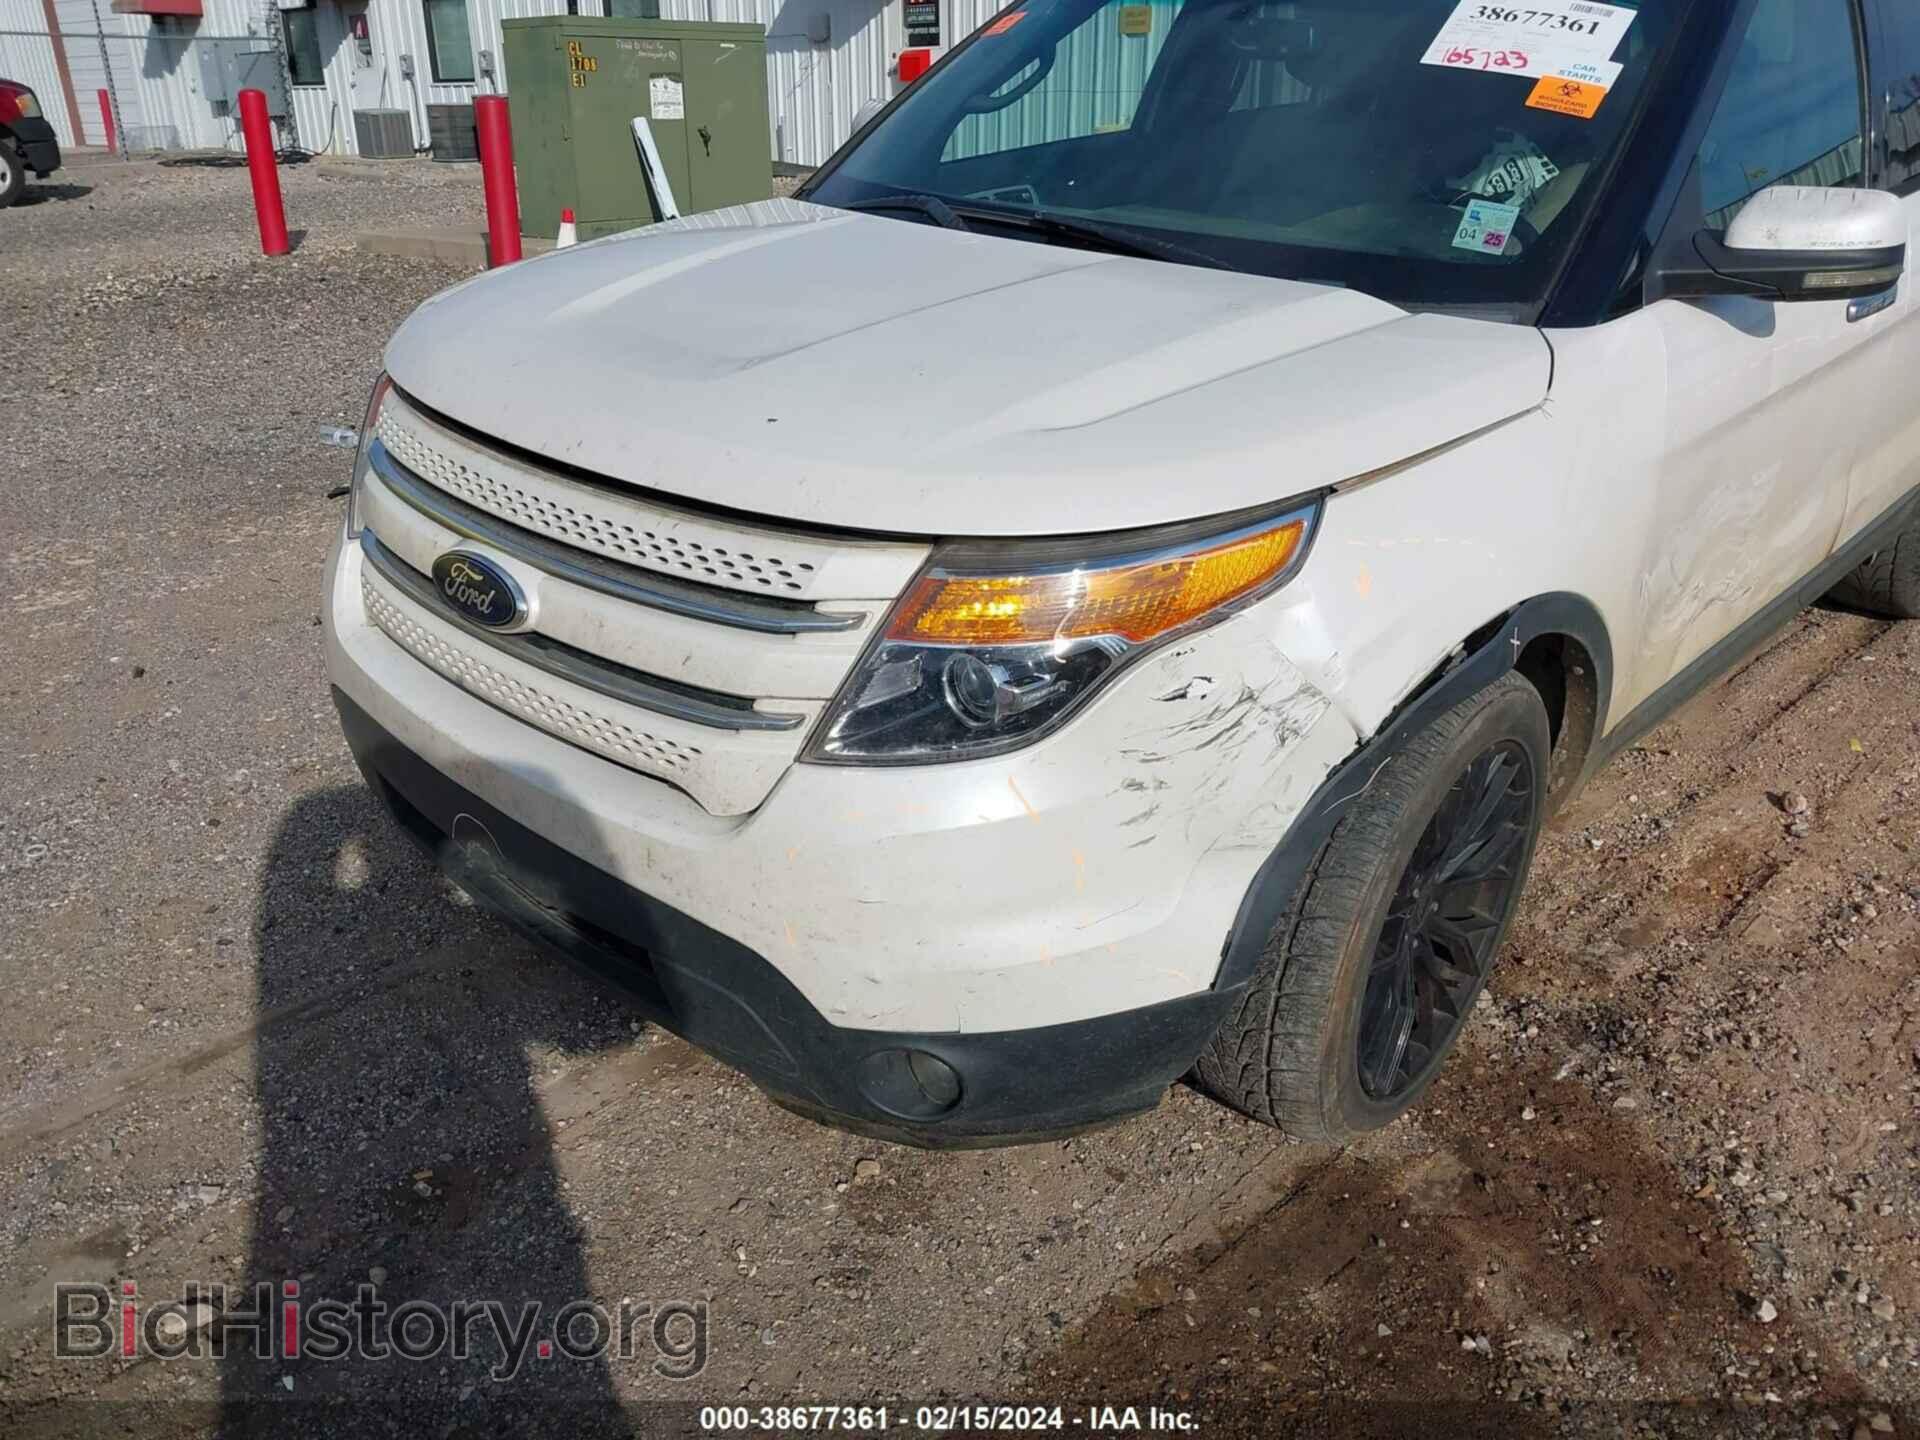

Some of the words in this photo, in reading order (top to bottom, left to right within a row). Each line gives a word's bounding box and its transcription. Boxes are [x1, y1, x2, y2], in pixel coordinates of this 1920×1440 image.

[1469, 5, 1600, 35] 38677361
[568, 41, 582, 56] CL
[1558, 69, 1602, 83] STARTS
[1572, 62, 1597, 73] CAR
[1459, 227, 1477, 240] 04
[1484, 230, 1505, 247] 25
[445, 562, 496, 614] Ford
